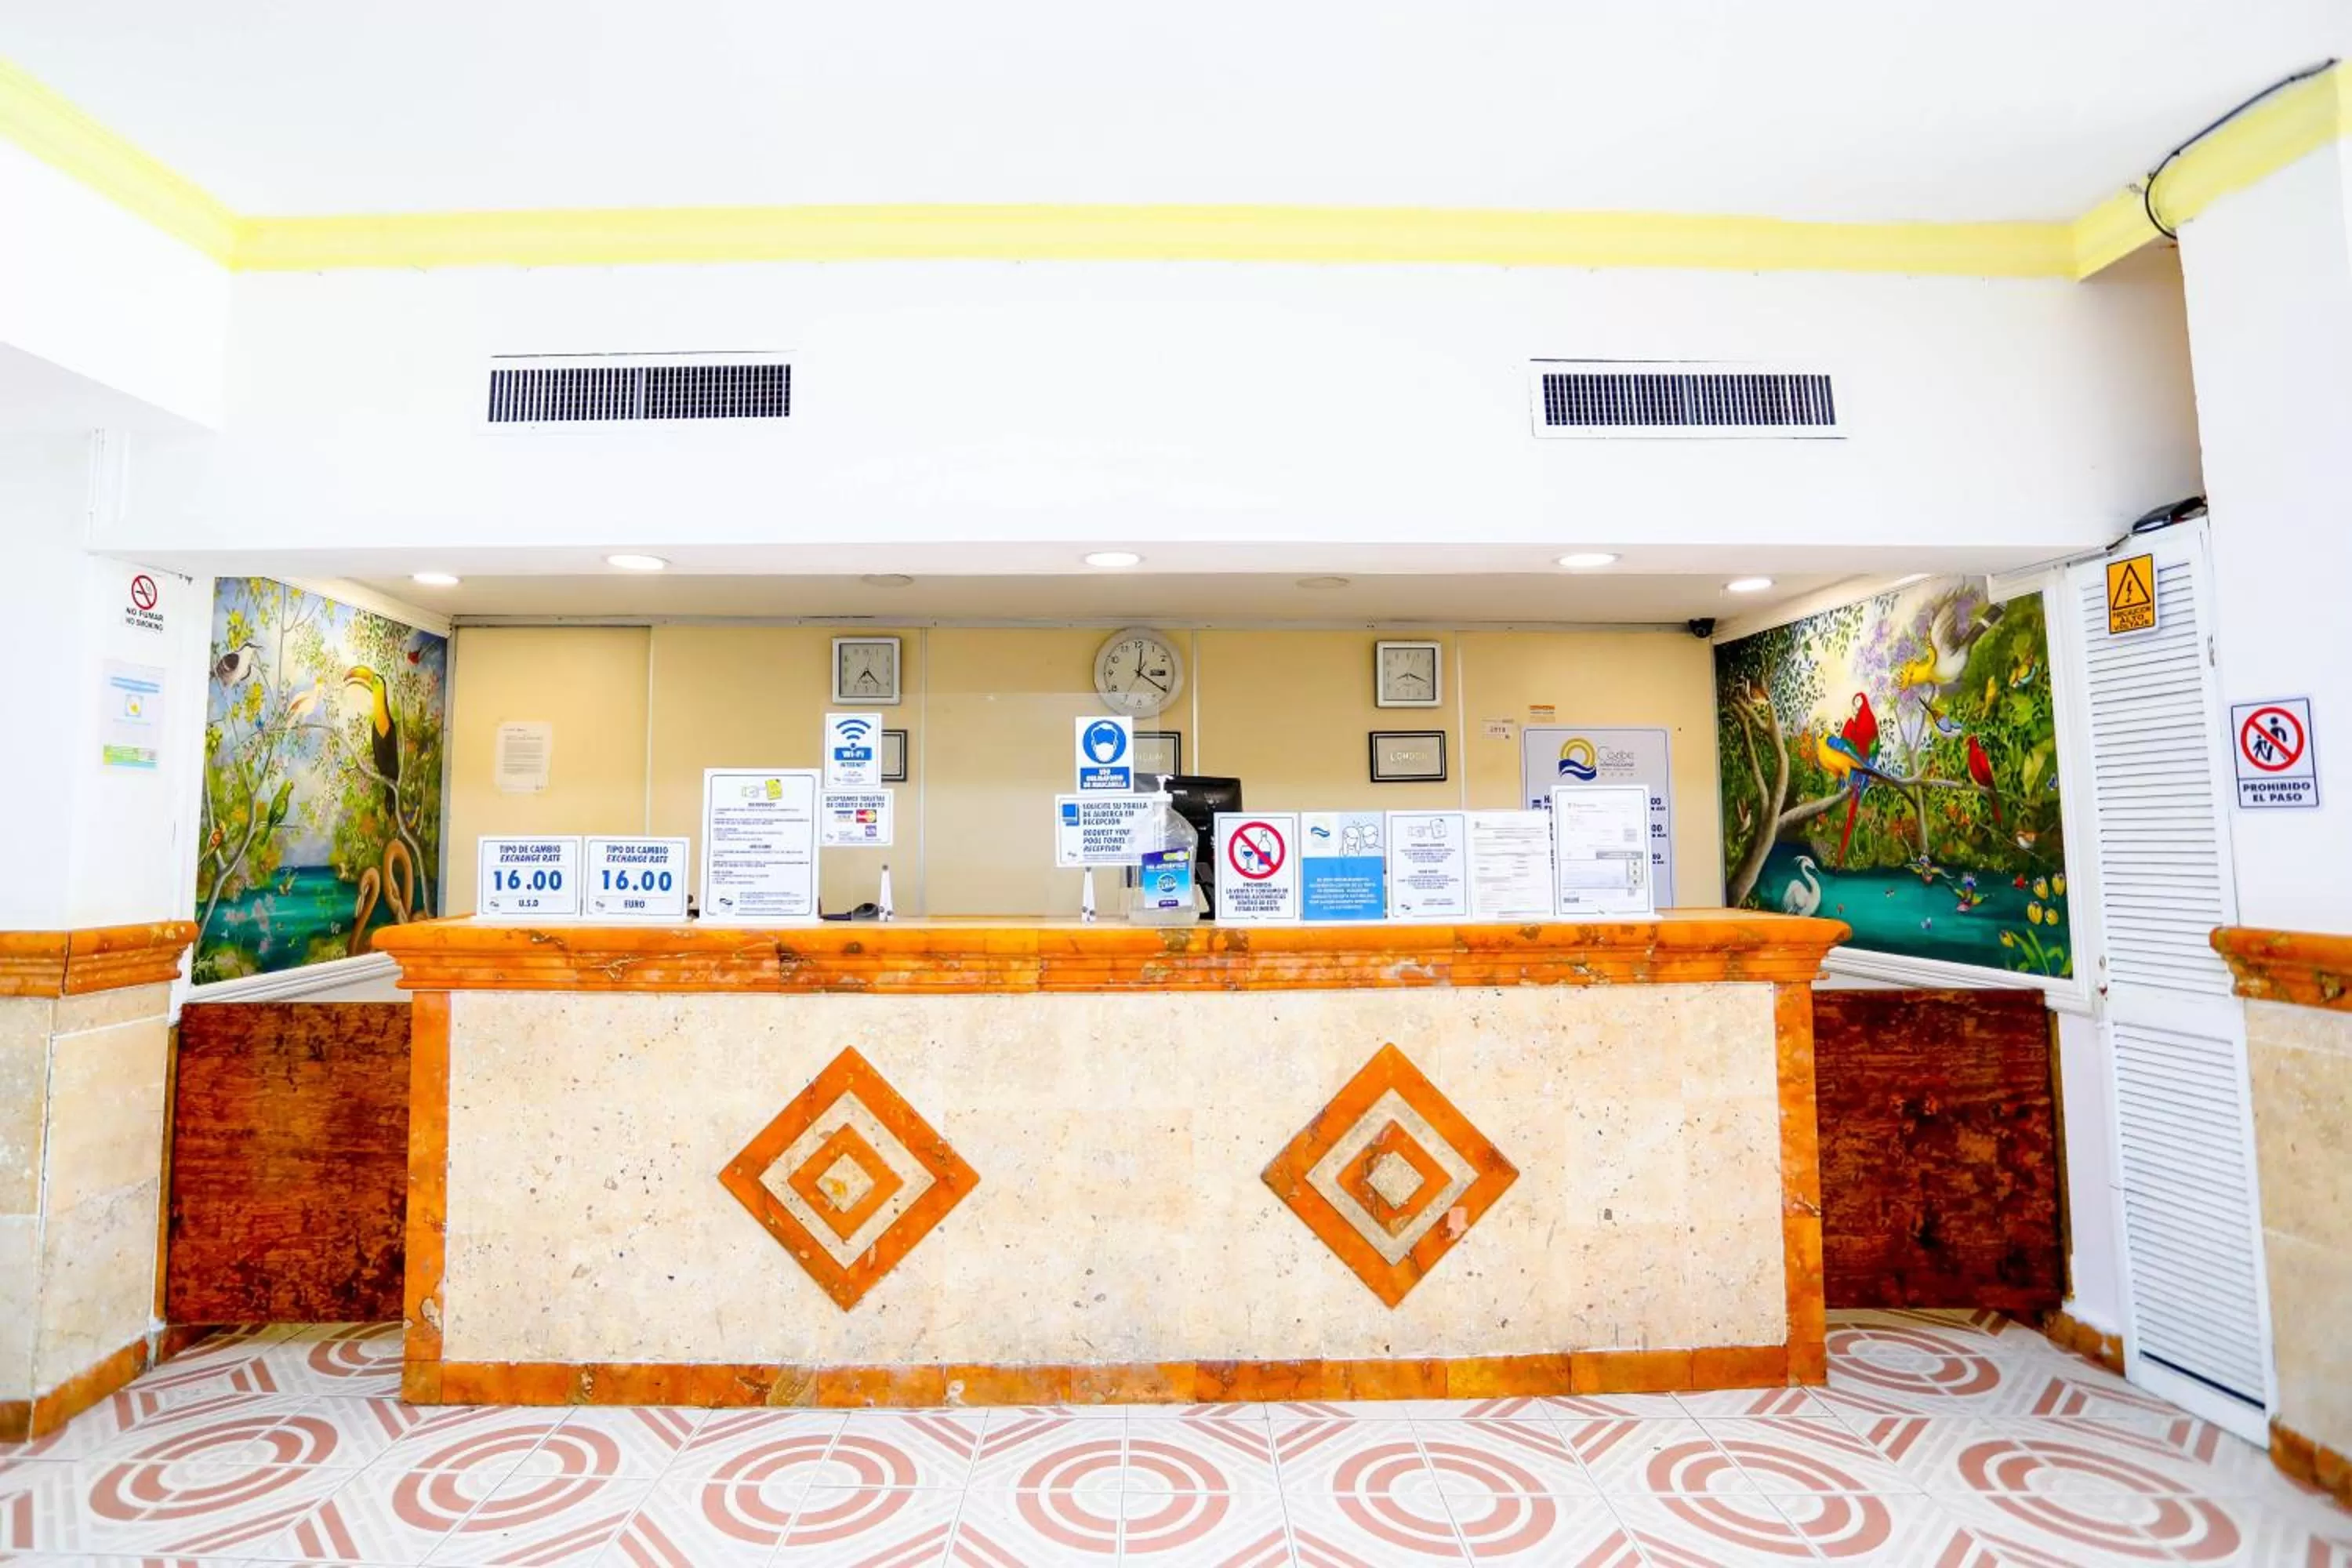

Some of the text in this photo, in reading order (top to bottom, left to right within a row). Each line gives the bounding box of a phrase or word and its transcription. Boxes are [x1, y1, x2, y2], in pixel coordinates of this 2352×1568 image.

[139, 610, 163, 622] FUMAR
[2119, 614, 2144, 624] ALTO
[136, 619, 163, 630] SMOKING
[2243, 782, 2310, 792] PROHIBIDO
[2252, 793, 2303, 802] EL PASO
[499, 844, 561, 853] TIPO DE CAMBIO
[606, 844, 669, 854] TIPO DE CAMBIO
[500, 854, 561, 862] EXCHANGE RATE
[606, 854, 668, 863] EXCHANGE RATE
[493, 869, 563, 891] 16.00
[601, 869, 672, 891] 16.00
[624, 899, 644, 908] EURO
